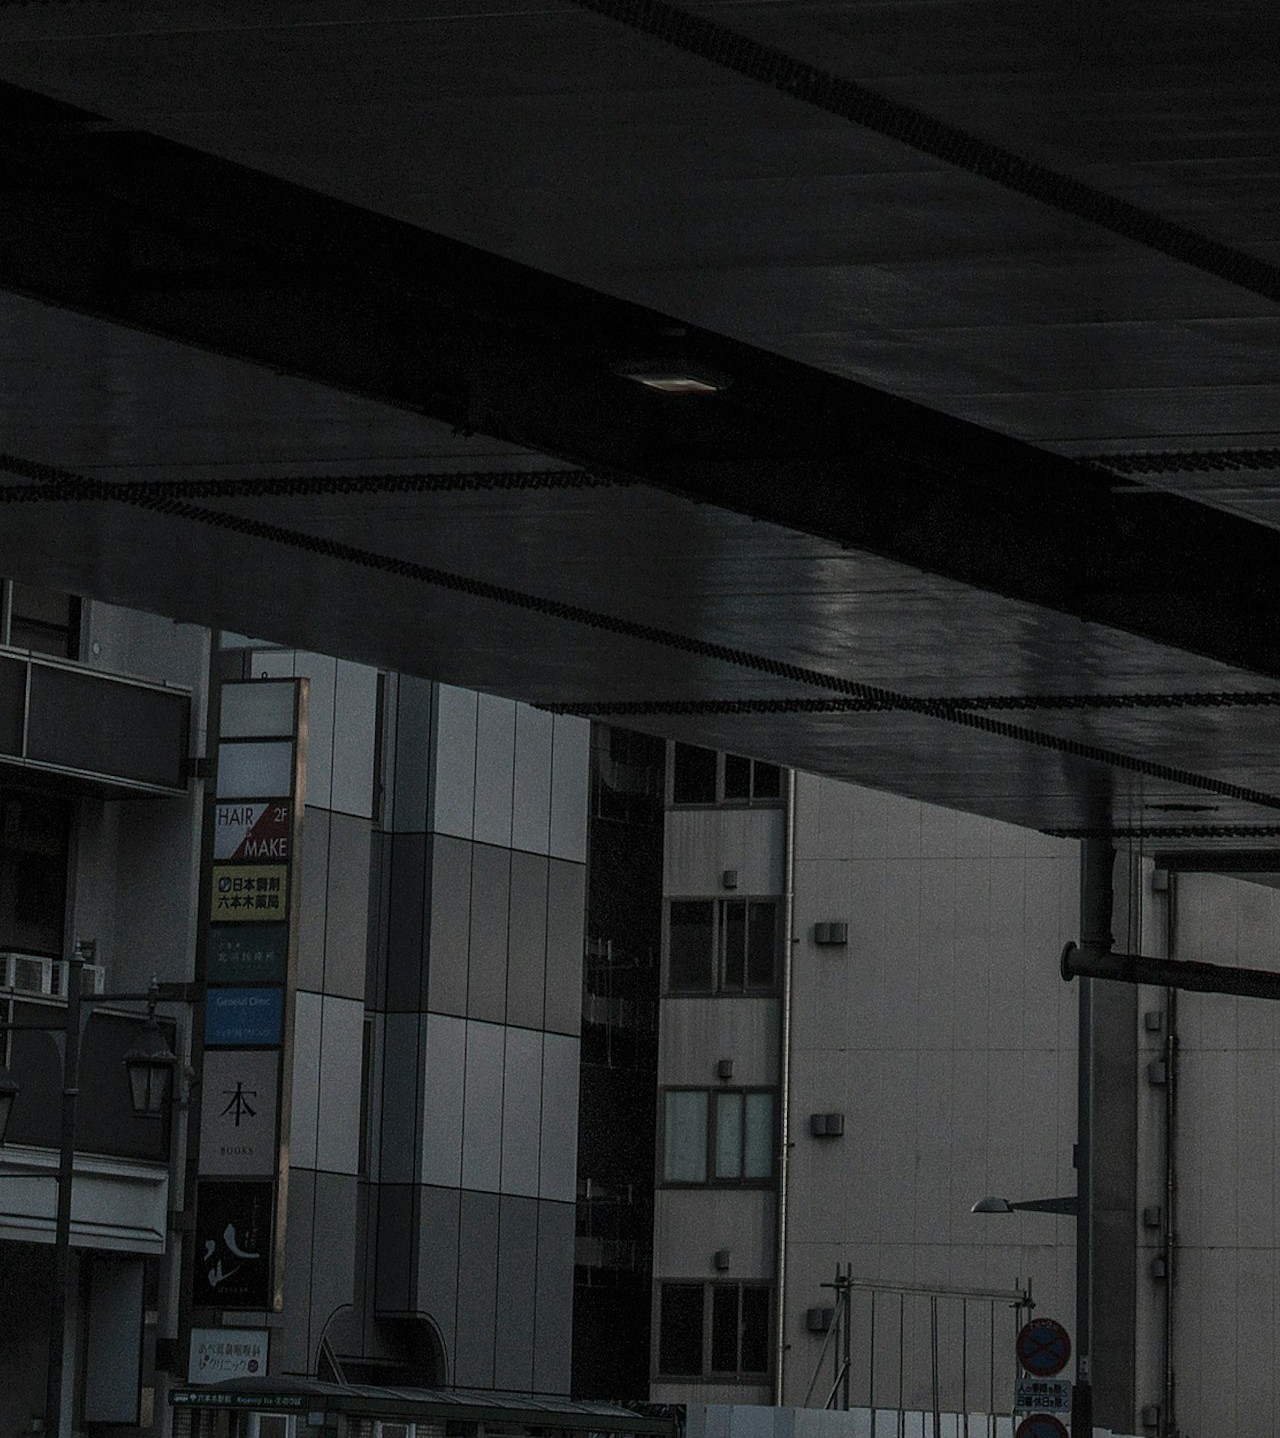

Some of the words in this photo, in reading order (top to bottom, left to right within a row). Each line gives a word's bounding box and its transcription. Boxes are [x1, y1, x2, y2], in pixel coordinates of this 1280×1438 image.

[218, 807, 254, 826] HAIR
[273, 807, 288, 823] 2F
[244, 838, 288, 858] MAKE
[217, 893, 280, 910] 六本木薬局
[219, 1082, 257, 1127] 本
[220, 1146, 254, 1156] BOOKS
[209, 1358, 246, 1371] クリニック
